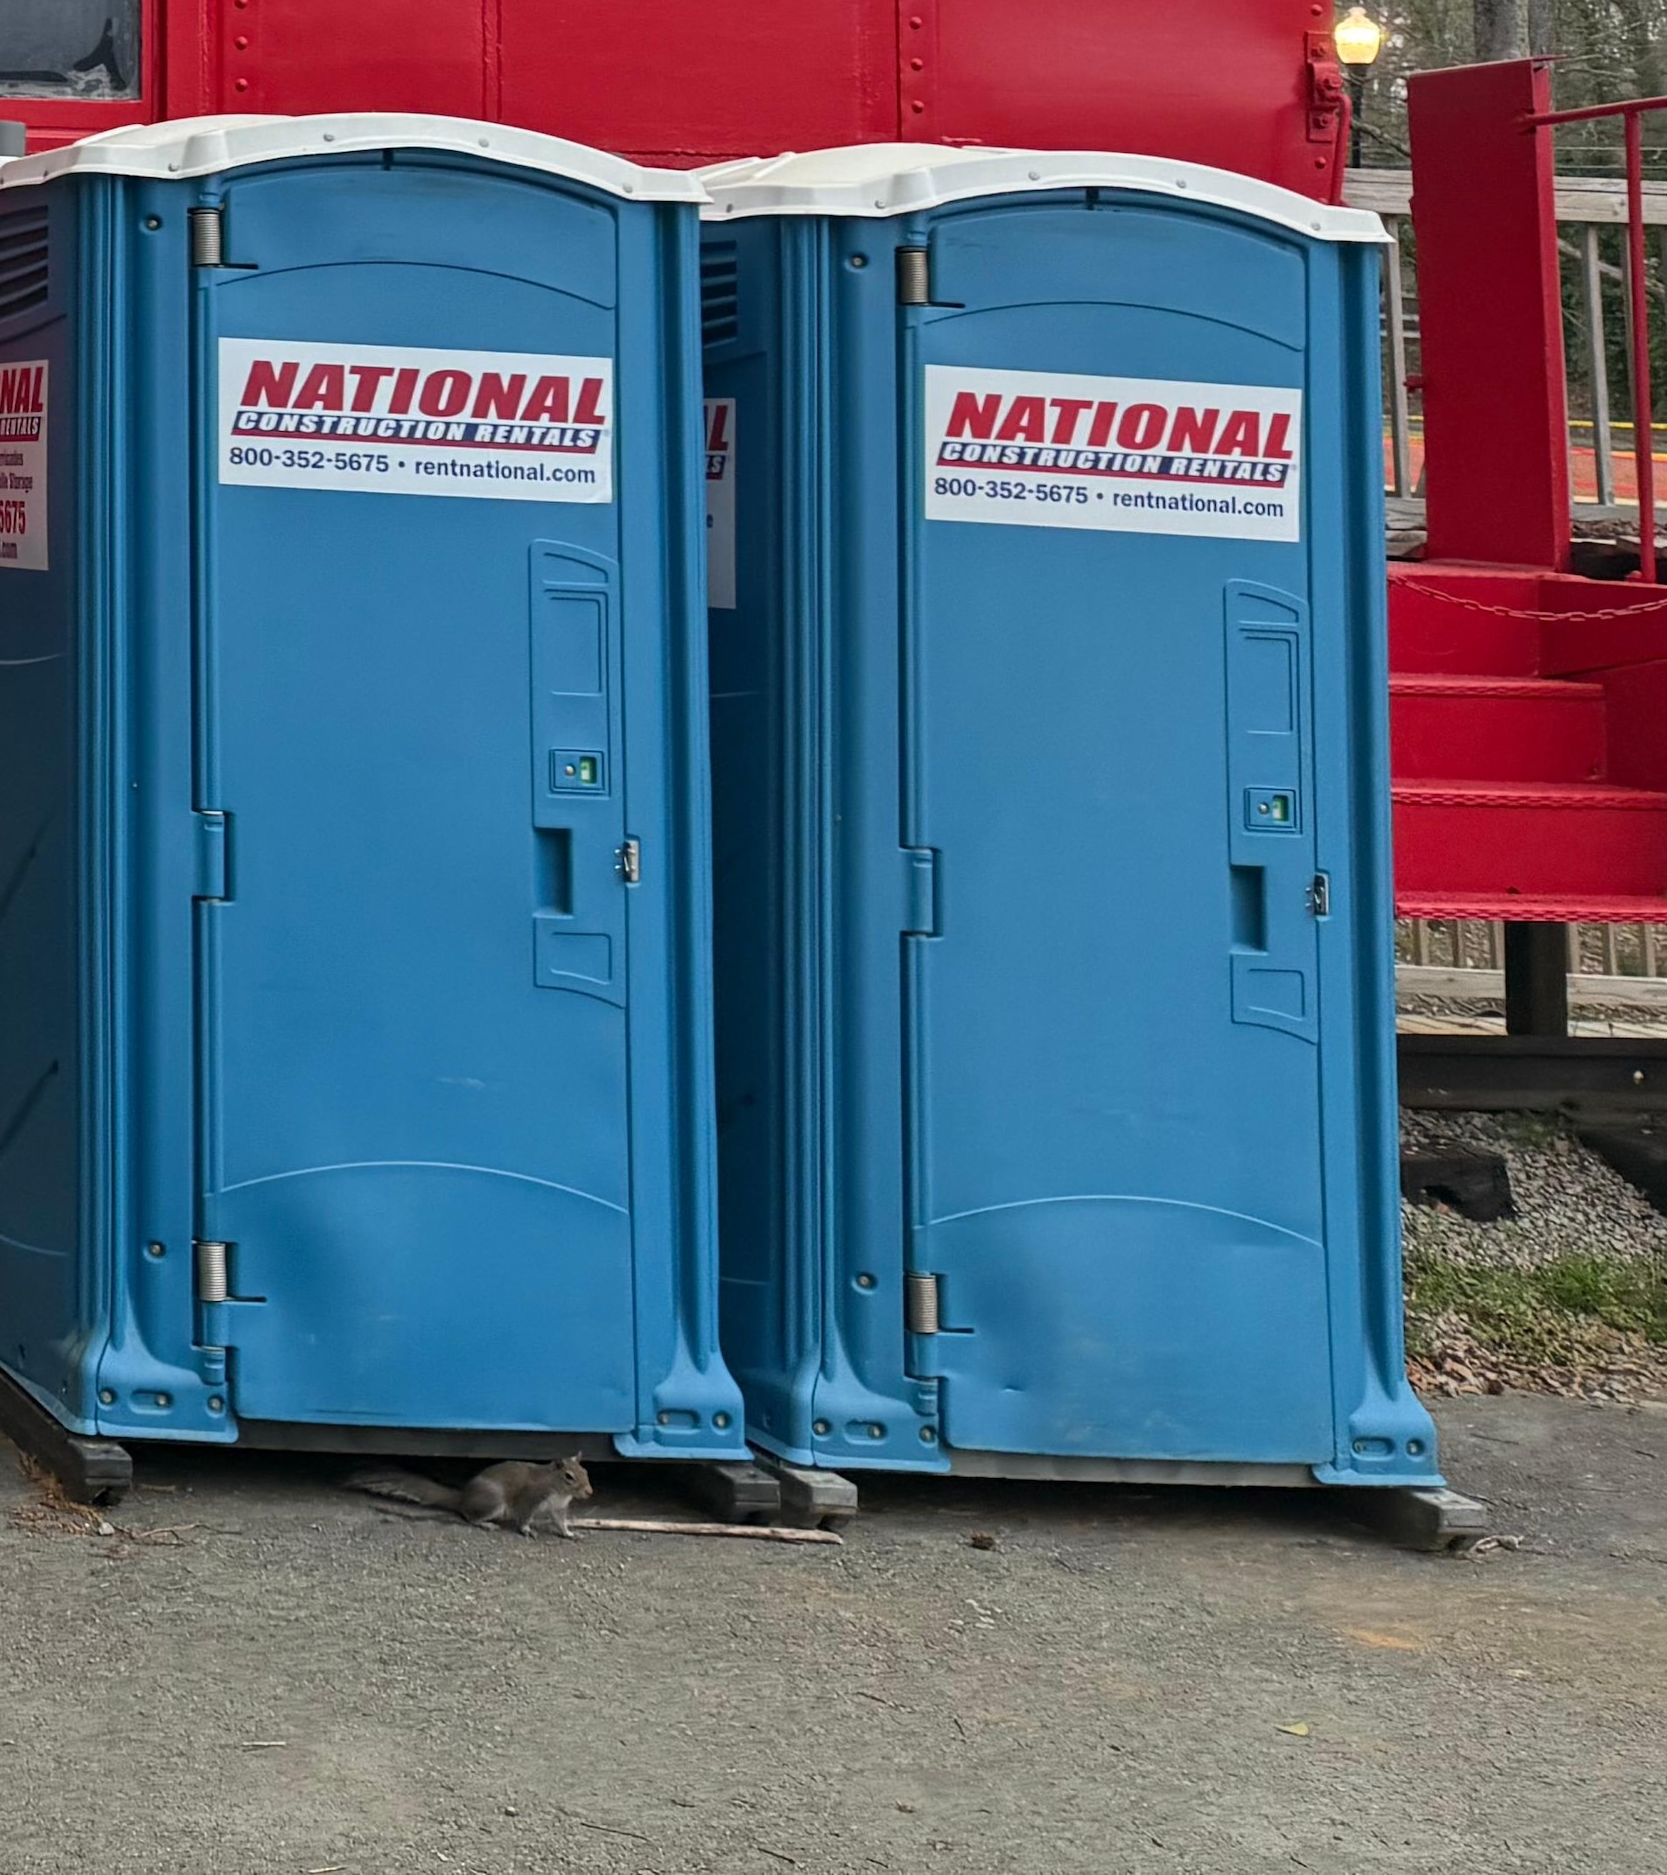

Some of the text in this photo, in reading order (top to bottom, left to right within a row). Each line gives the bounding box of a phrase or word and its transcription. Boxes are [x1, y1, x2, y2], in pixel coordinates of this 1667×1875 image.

[240, 359, 606, 425] NATIONAL
[0, 416, 40, 436] RENTALS
[237, 411, 596, 448] CONSTRUCTION RENTALS
[945, 391, 1293, 459] NATIONAL
[229, 446, 596, 484] 800-352-5675 rentnational.com
[941, 442, 1283, 483] CONSTRUCTION RENTALS
[934, 477, 1284, 518] 800-352-5675 rentnational.com
